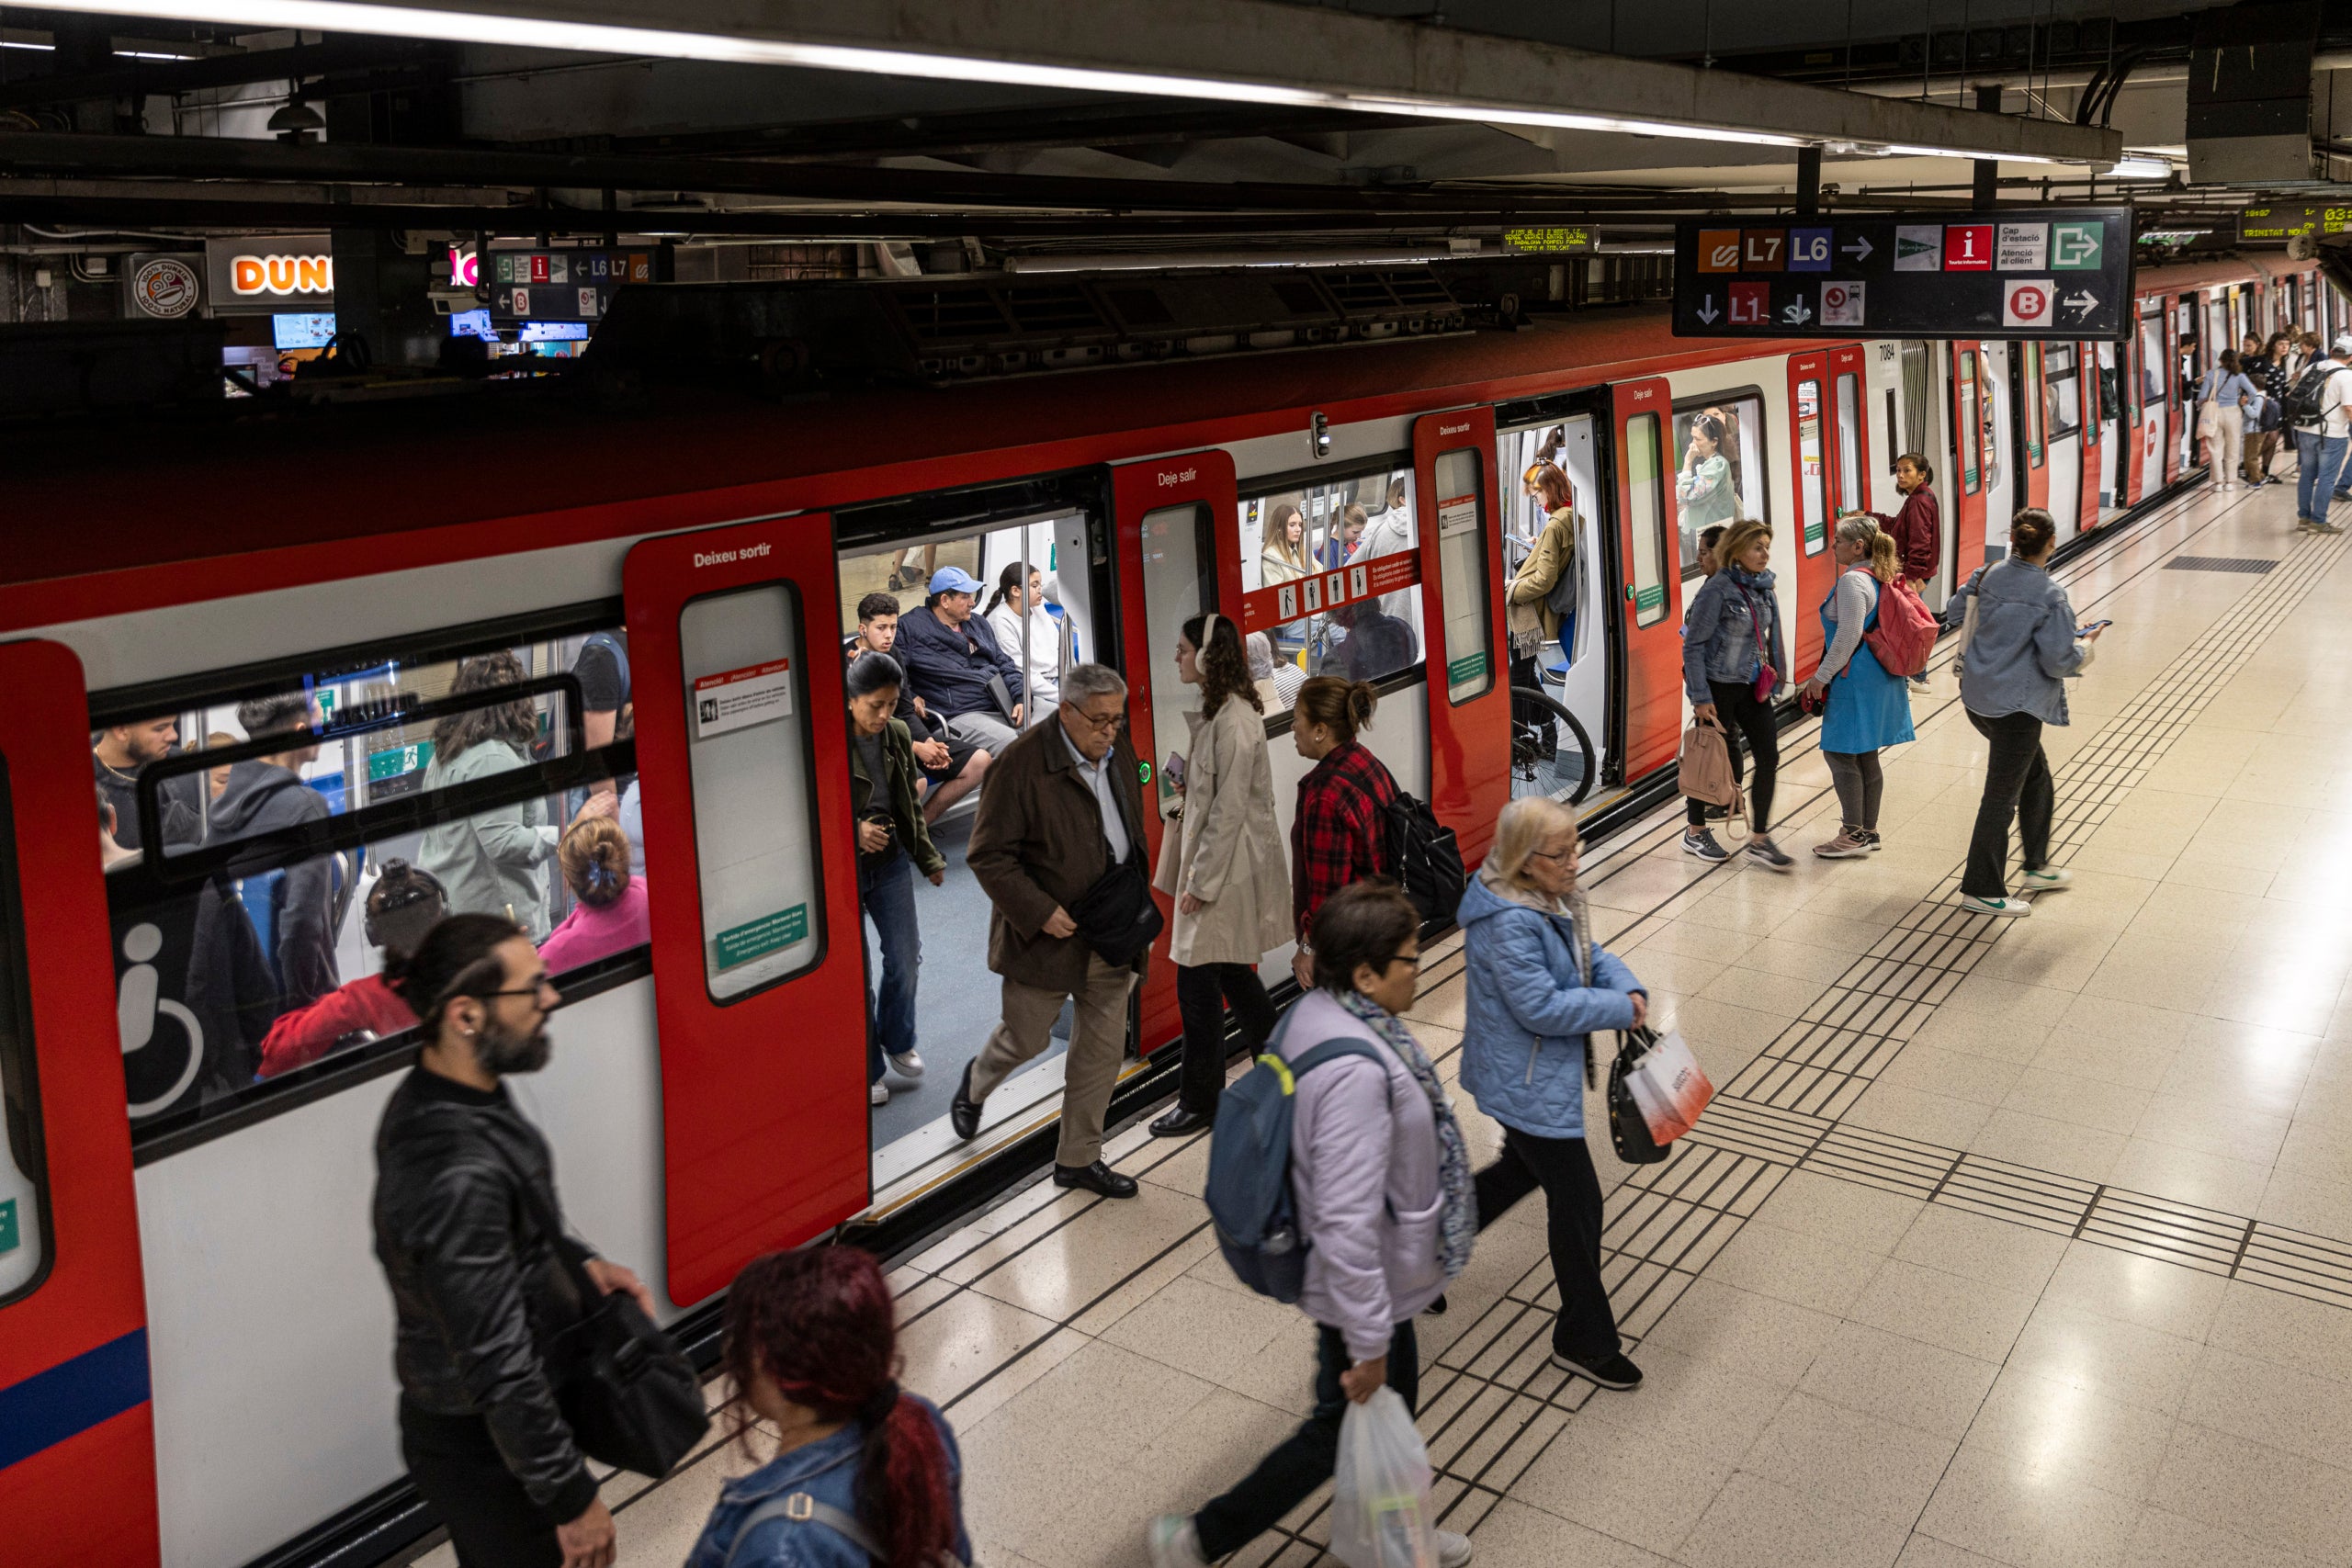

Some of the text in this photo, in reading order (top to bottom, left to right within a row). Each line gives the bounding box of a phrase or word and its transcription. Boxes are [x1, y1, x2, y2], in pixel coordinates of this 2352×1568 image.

[2001, 234, 2040, 243] d'estació
[2002, 227, 2018, 235] Cap
[2244, 228, 2284, 237] TRINITAT
[1747, 236, 1828, 262] L7 L6
[235, 258, 334, 291] DUN
[592, 260, 627, 276] L6 L7
[164, 294, 193, 313] NATURAL
[1730, 296, 1758, 321] L1
[2018, 292, 2040, 314] B
[1879, 343, 1894, 362] 7084
[1634, 388, 1653, 401] Deje salir
[1158, 468, 1197, 488] Deje salir
[694, 542, 772, 568] Deixeu sortir
[700, 676, 724, 688] Atenció!
